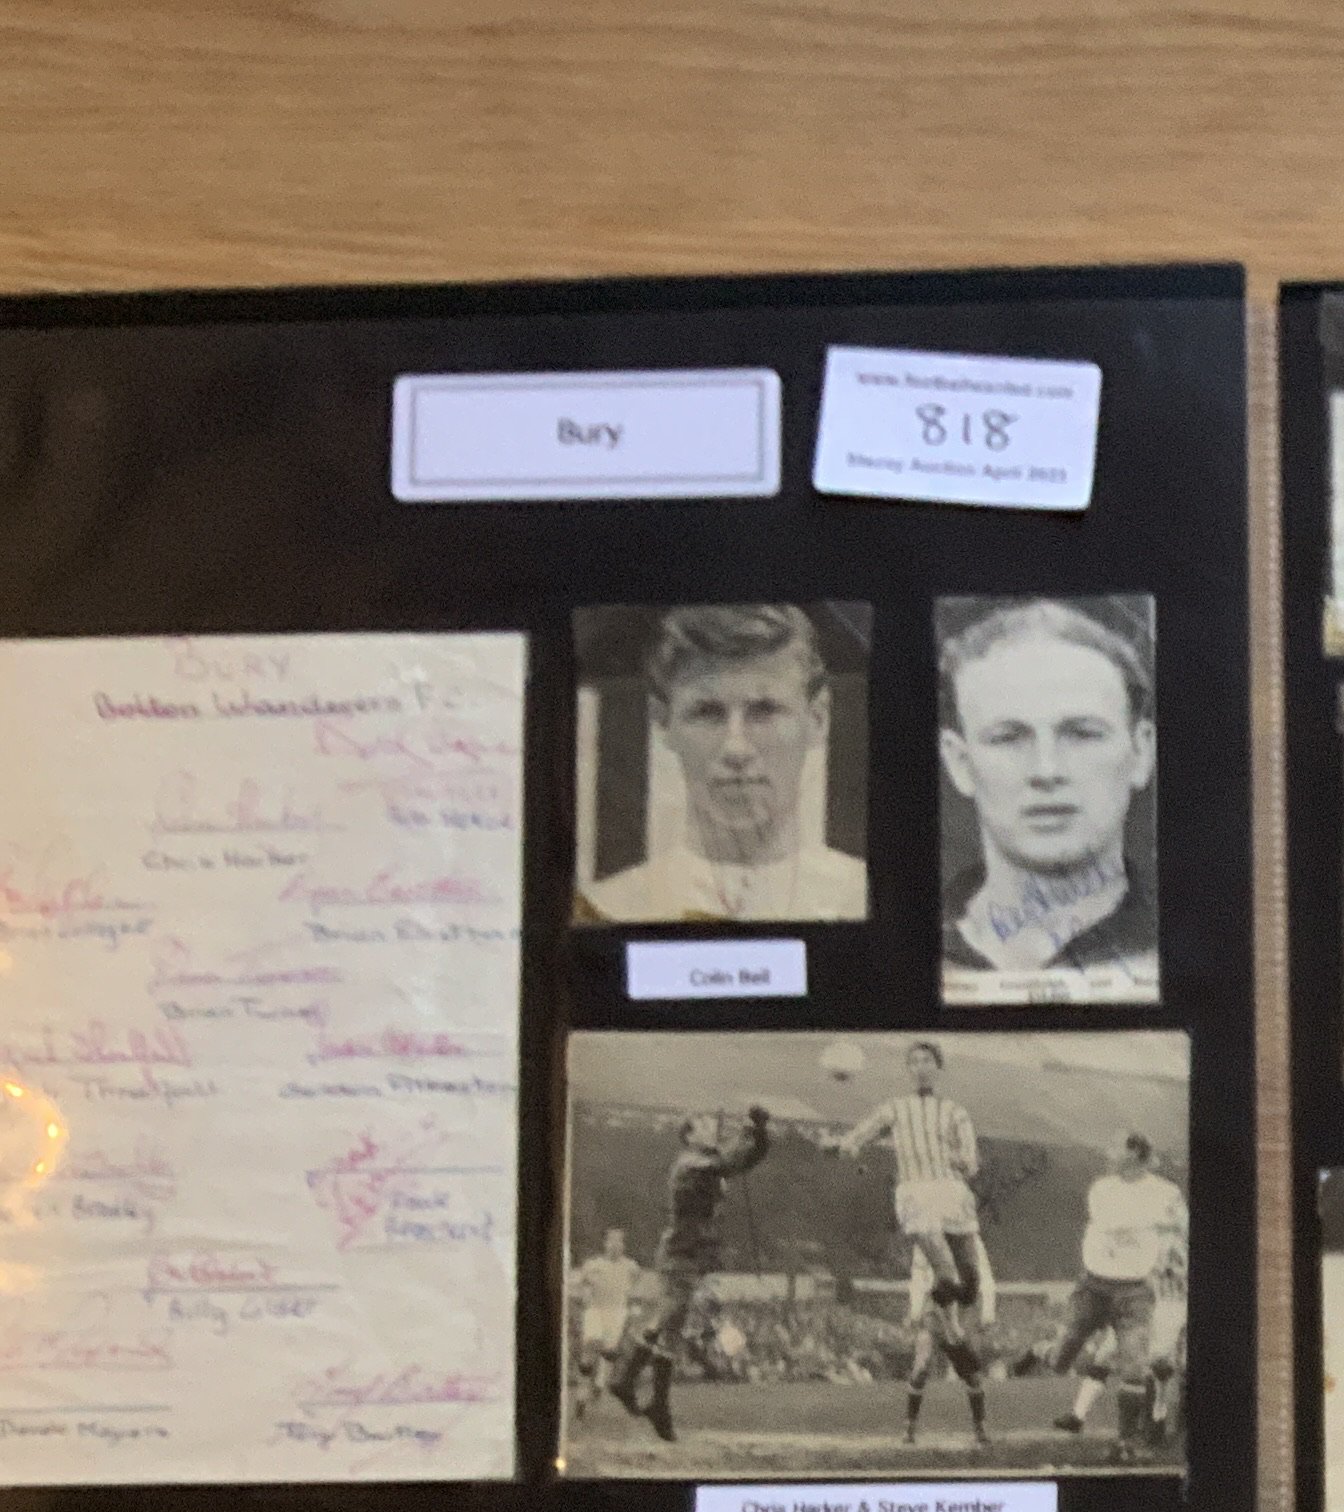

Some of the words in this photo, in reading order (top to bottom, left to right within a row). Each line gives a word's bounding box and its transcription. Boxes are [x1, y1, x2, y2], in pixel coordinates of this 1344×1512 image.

[556, 417, 624, 450] Bury
[915, 402, 1019, 452] 818
[690, 967, 734, 987] Colin
[738, 966, 771, 986] Bell
